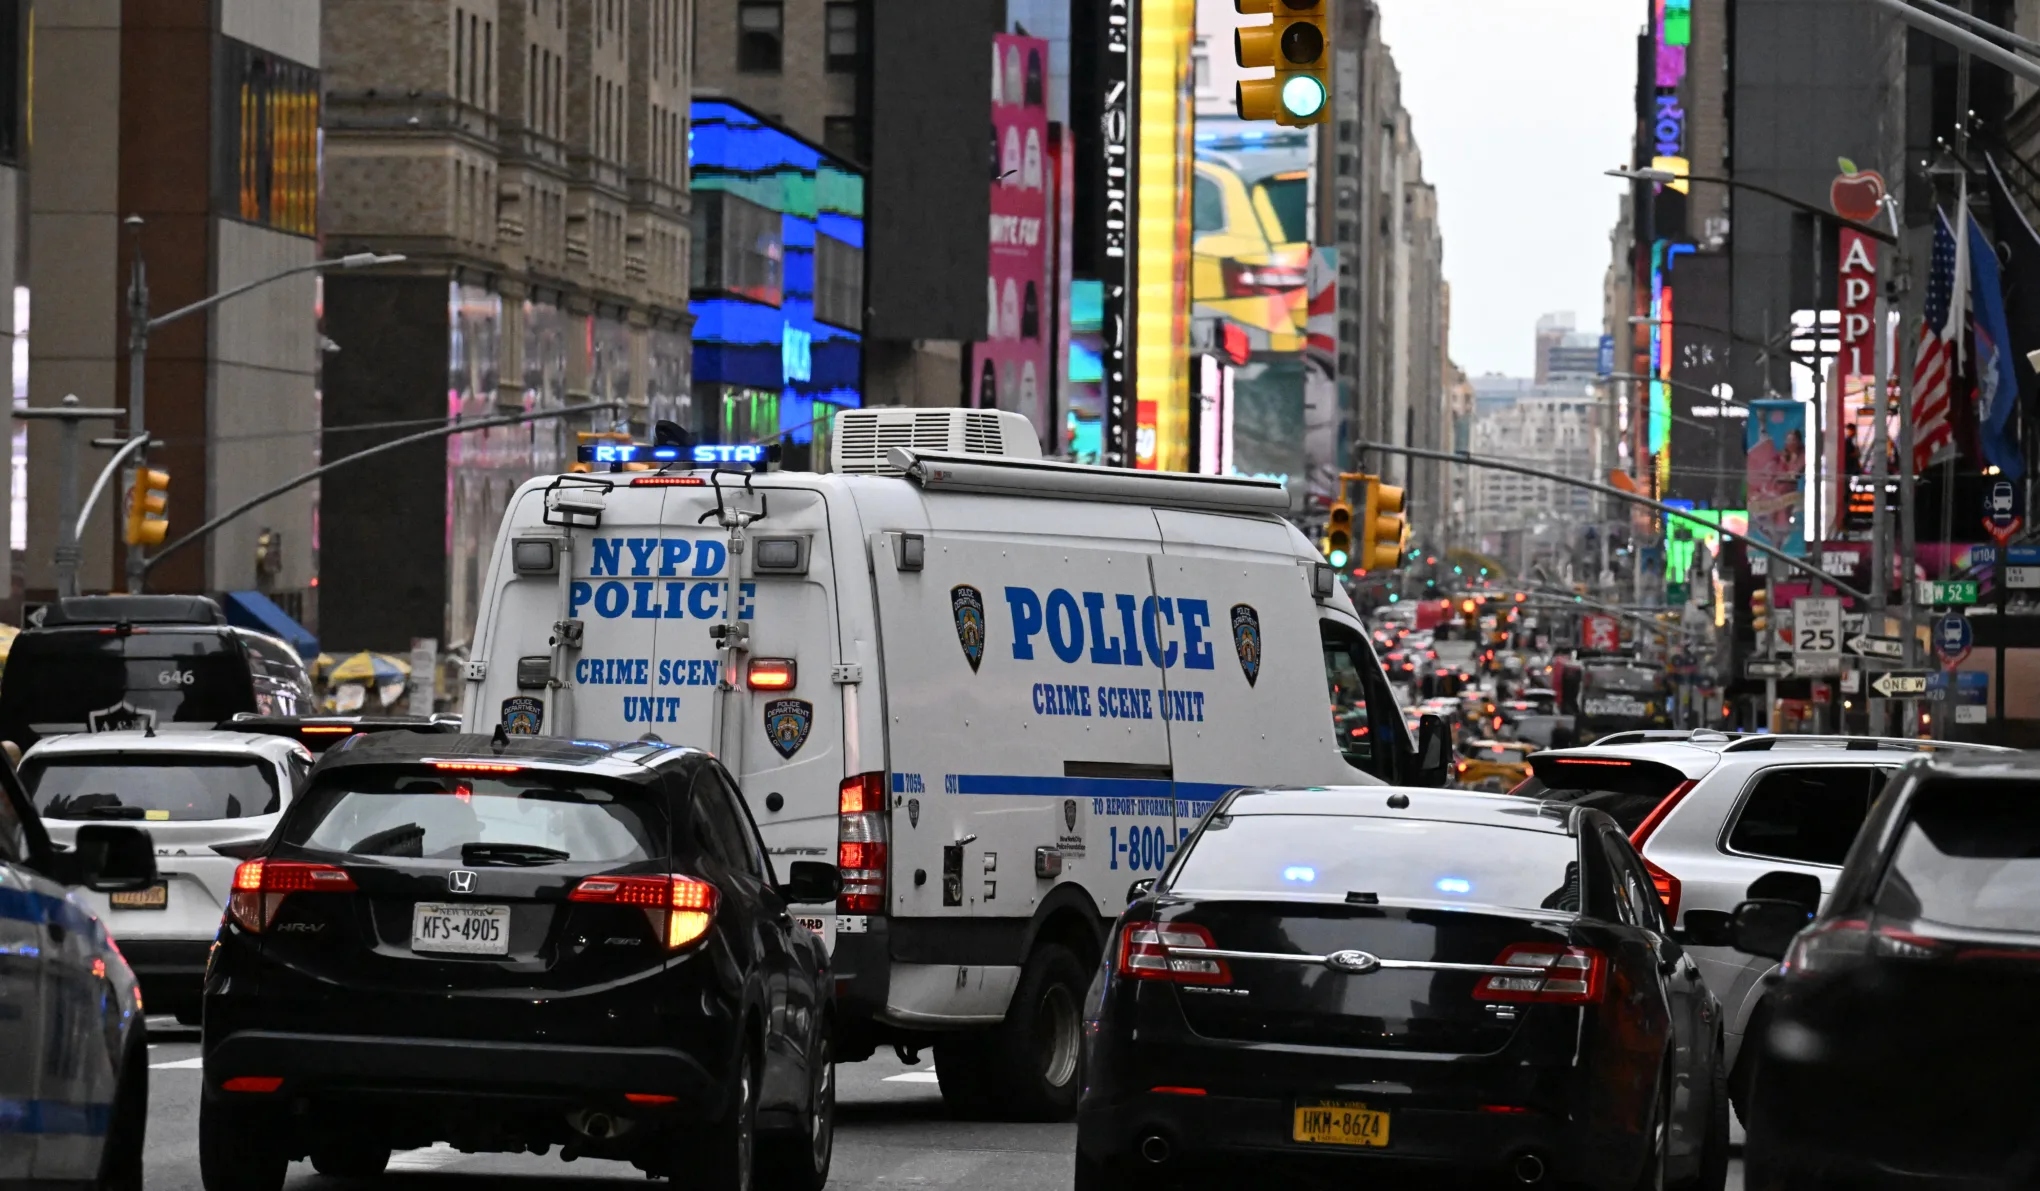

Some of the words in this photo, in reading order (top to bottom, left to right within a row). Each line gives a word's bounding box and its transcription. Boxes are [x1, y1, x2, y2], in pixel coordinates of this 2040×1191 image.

[1106, 80, 1127, 257] EDITION
[694, 445, 761, 462] STA
[589, 538, 727, 577] NYPD
[568, 581, 756, 620] POLICE
[957, 588, 974, 598] POLICE
[1934, 584, 1945, 600] W
[1948, 584, 1963, 602] 52
[1004, 586, 1215, 671] POLICE
[1800, 628, 1836, 651] 25
[1885, 642, 1902, 653] WA
[158, 669, 195, 685] 646
[575, 658, 649, 685] CRIME
[658, 659, 723, 686] SCEN
[1882, 679, 1908, 690] ONE
[503, 705, 541, 715] DEPARTMENT
[623, 696, 681, 723] UNIT
[1032, 683, 1092, 716] CRIME
[1098, 687, 1154, 720] SCENE
[1160, 691, 1205, 722] UNIT
[767, 706, 810, 718] DEPARTMENT
[945, 774, 958, 794] CSU
[1093, 798, 1104, 815] TO
[1106, 798, 1137, 816] REPORT
[1138, 799, 1189, 818] INFORMATION
[440, 908, 460, 917] NEW
[463, 909, 486, 917] YORK
[796, 918, 824, 930] ARD
[1338, 952, 1365, 966] Ford
